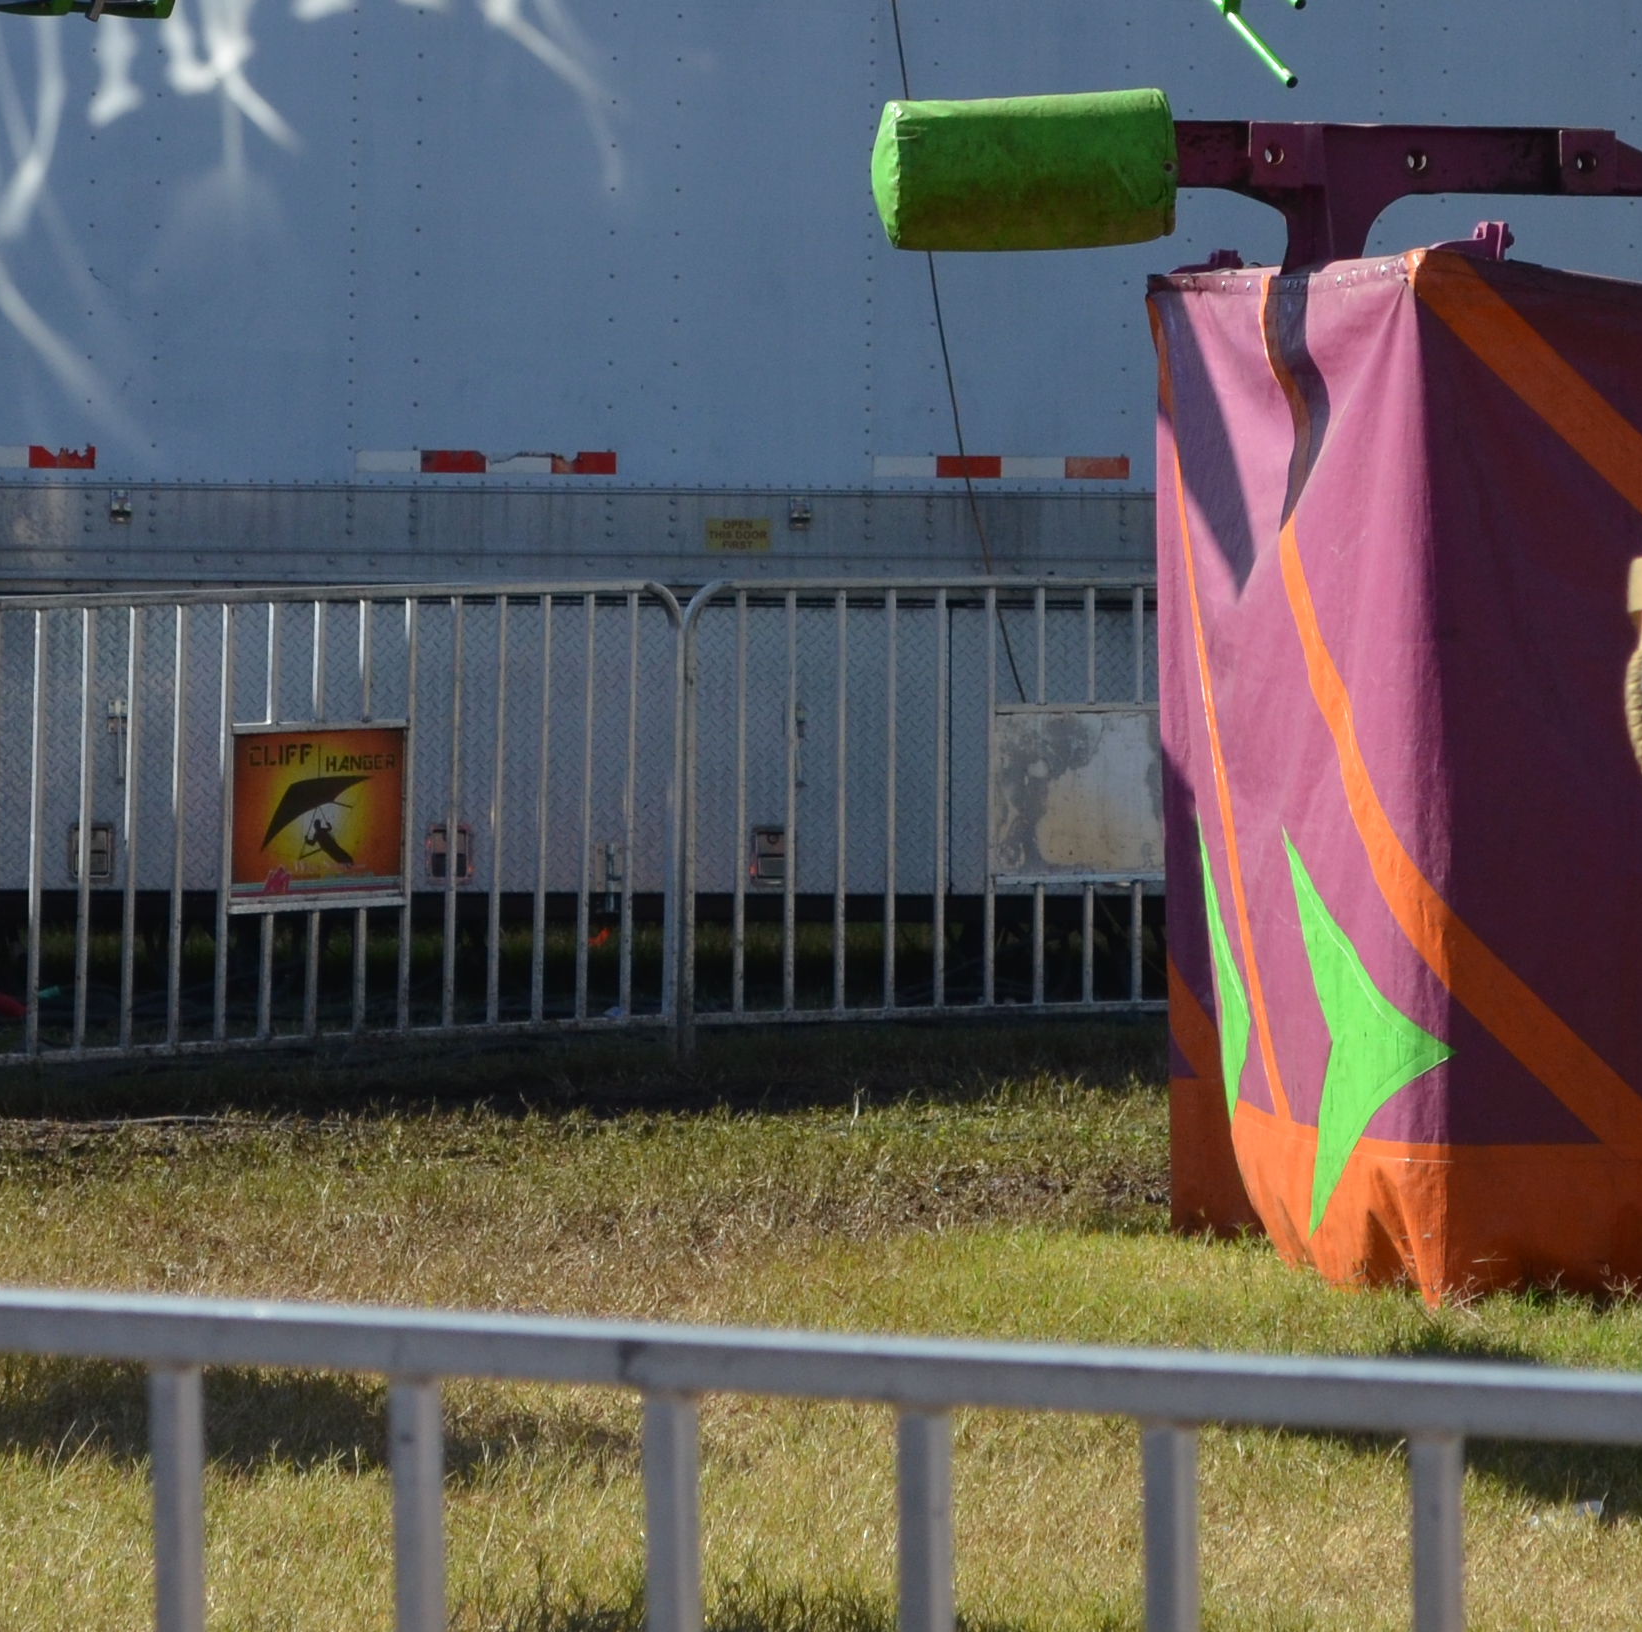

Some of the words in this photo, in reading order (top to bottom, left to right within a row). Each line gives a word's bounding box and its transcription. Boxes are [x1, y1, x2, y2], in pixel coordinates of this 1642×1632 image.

[723, 520, 753, 529] OPEN
[710, 531, 732, 539] THIS
[736, 531, 767, 539] DOOR
[722, 541, 753, 549] FIRST
[250, 744, 312, 766] CLIFF
[326, 754, 396, 772] HANGER
